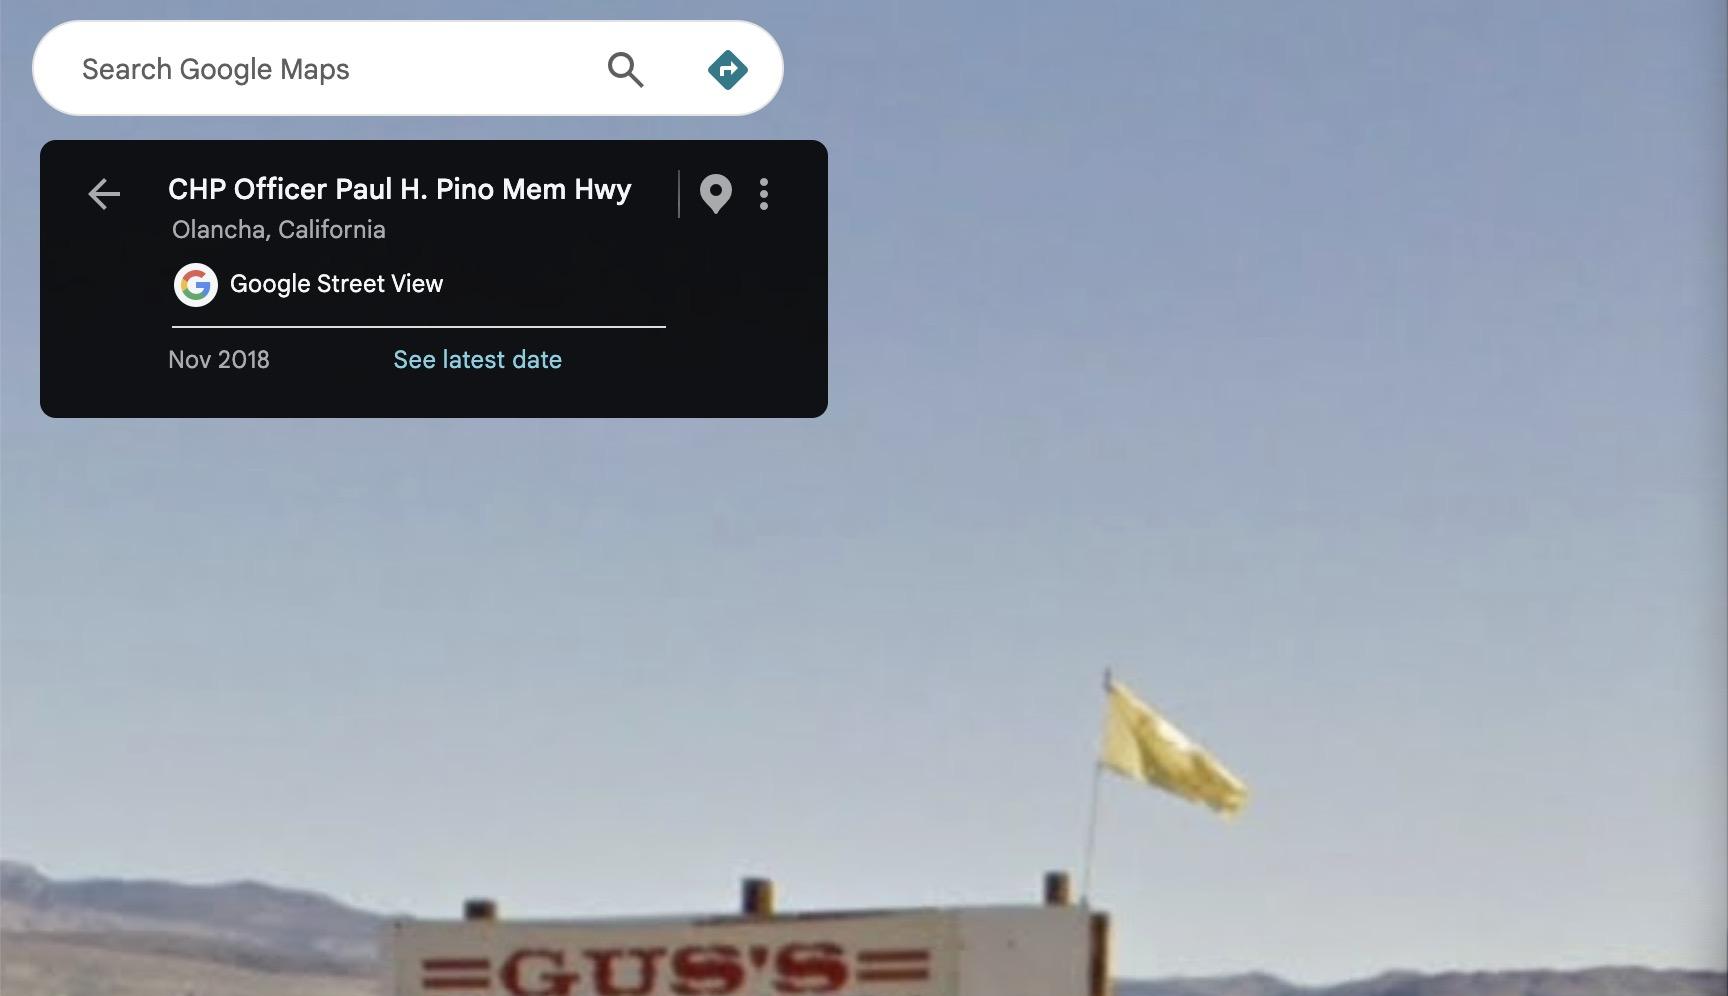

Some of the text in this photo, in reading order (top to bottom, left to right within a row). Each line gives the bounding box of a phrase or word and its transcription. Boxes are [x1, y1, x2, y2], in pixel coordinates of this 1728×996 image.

[82, 56, 350, 87] Search Google Maps
[168, 175, 633, 206] CHP Officer Paul H. Pino Mem Hwy
[172, 218, 386, 242] Olancha, California
[230, 272, 444, 299] Google Street View
[169, 349, 270, 370] Nov 2018
[393, 348, 563, 370] See latest date
